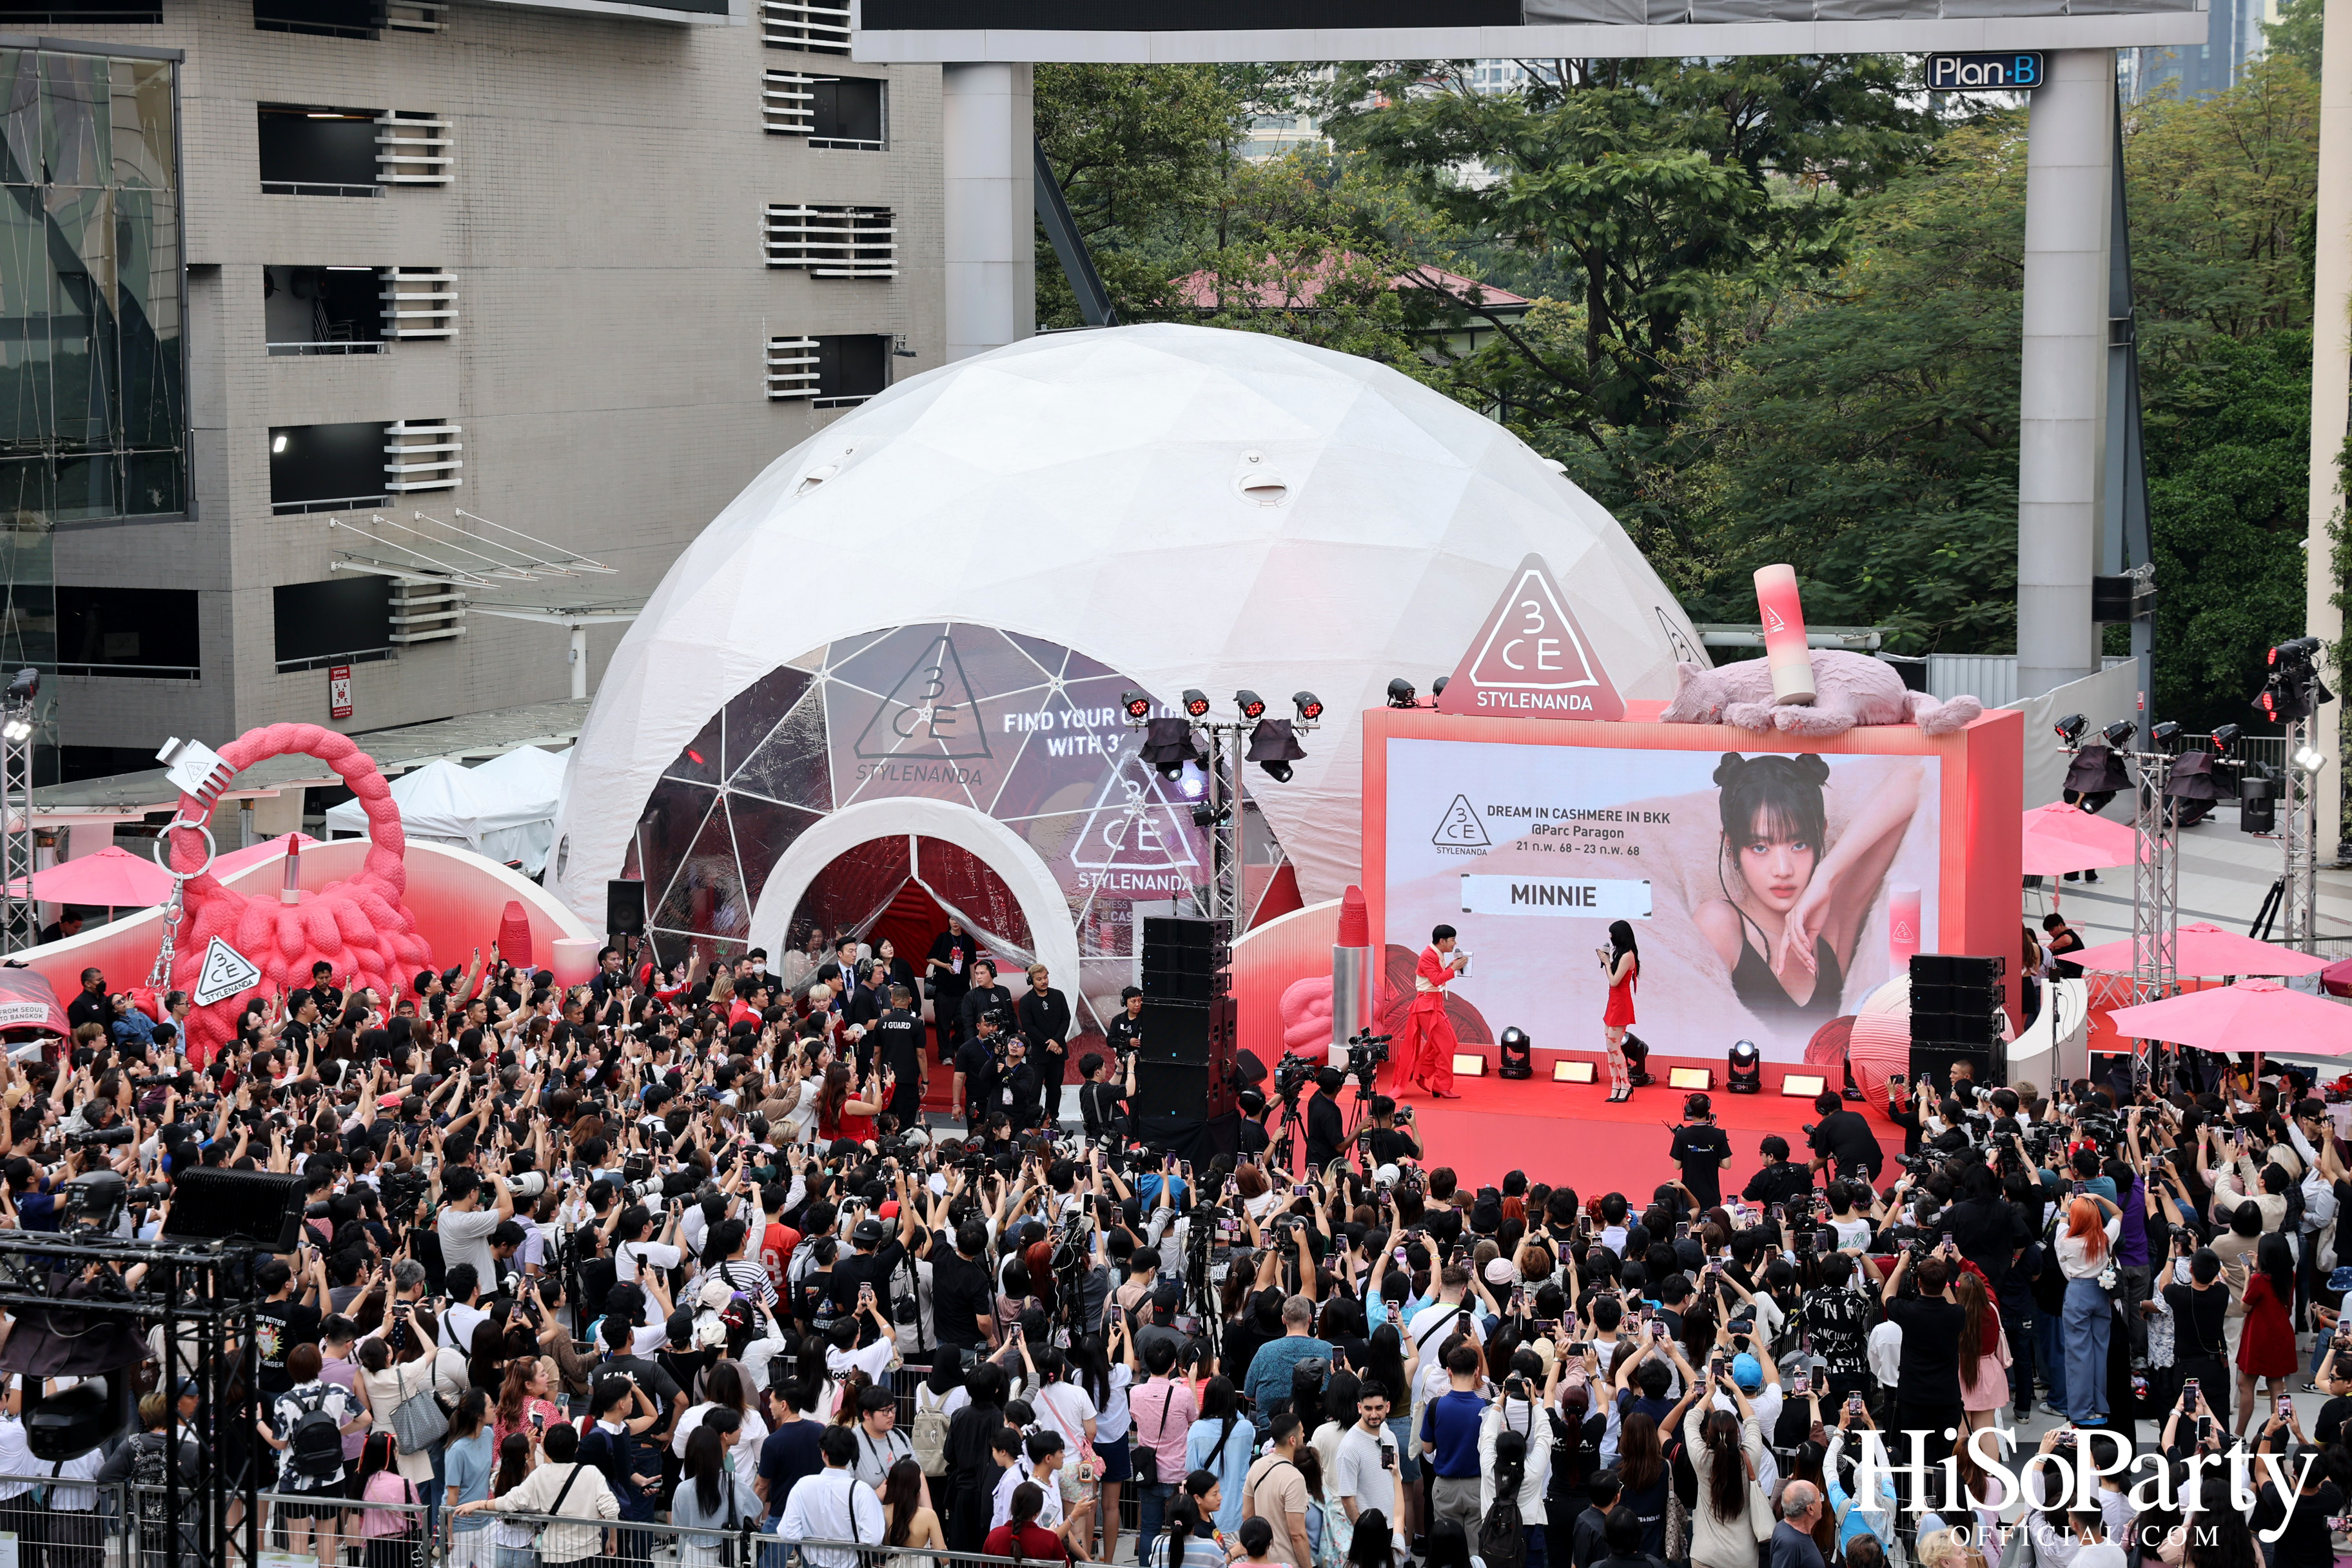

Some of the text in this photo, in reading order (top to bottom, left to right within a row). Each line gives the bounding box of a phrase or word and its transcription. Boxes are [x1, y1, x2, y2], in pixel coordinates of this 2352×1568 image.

[1476, 691, 1593, 711] STYLENANDA
[1003, 710, 1054, 732] FIND
[1060, 707, 1115, 729] YOUR
[1047, 735, 1101, 758] WITH
[856, 763, 983, 786] STYLENANDA
[1487, 805, 1671, 824] DREAM IN CASHMERE IN BKK
[1531, 823, 1624, 841] @Parc Paragon
[1436, 847, 1487, 856] STYLENANDA
[1516, 841, 1528, 850] 21
[1560, 843, 1572, 852] 68
[1583, 844, 1596, 854] 23
[1627, 846, 1640, 856] 68
[1078, 872, 1194, 892] STYLENANDA
[1511, 883, 1596, 907] MINNIE
[1110, 910, 1133, 922] CAS
[205, 979, 254, 1003] STYLENANDA
[888, 1021, 911, 1030] GUARD
[265, 1316, 287, 1328] BETTER
[262, 1360, 284, 1368] ONGER
